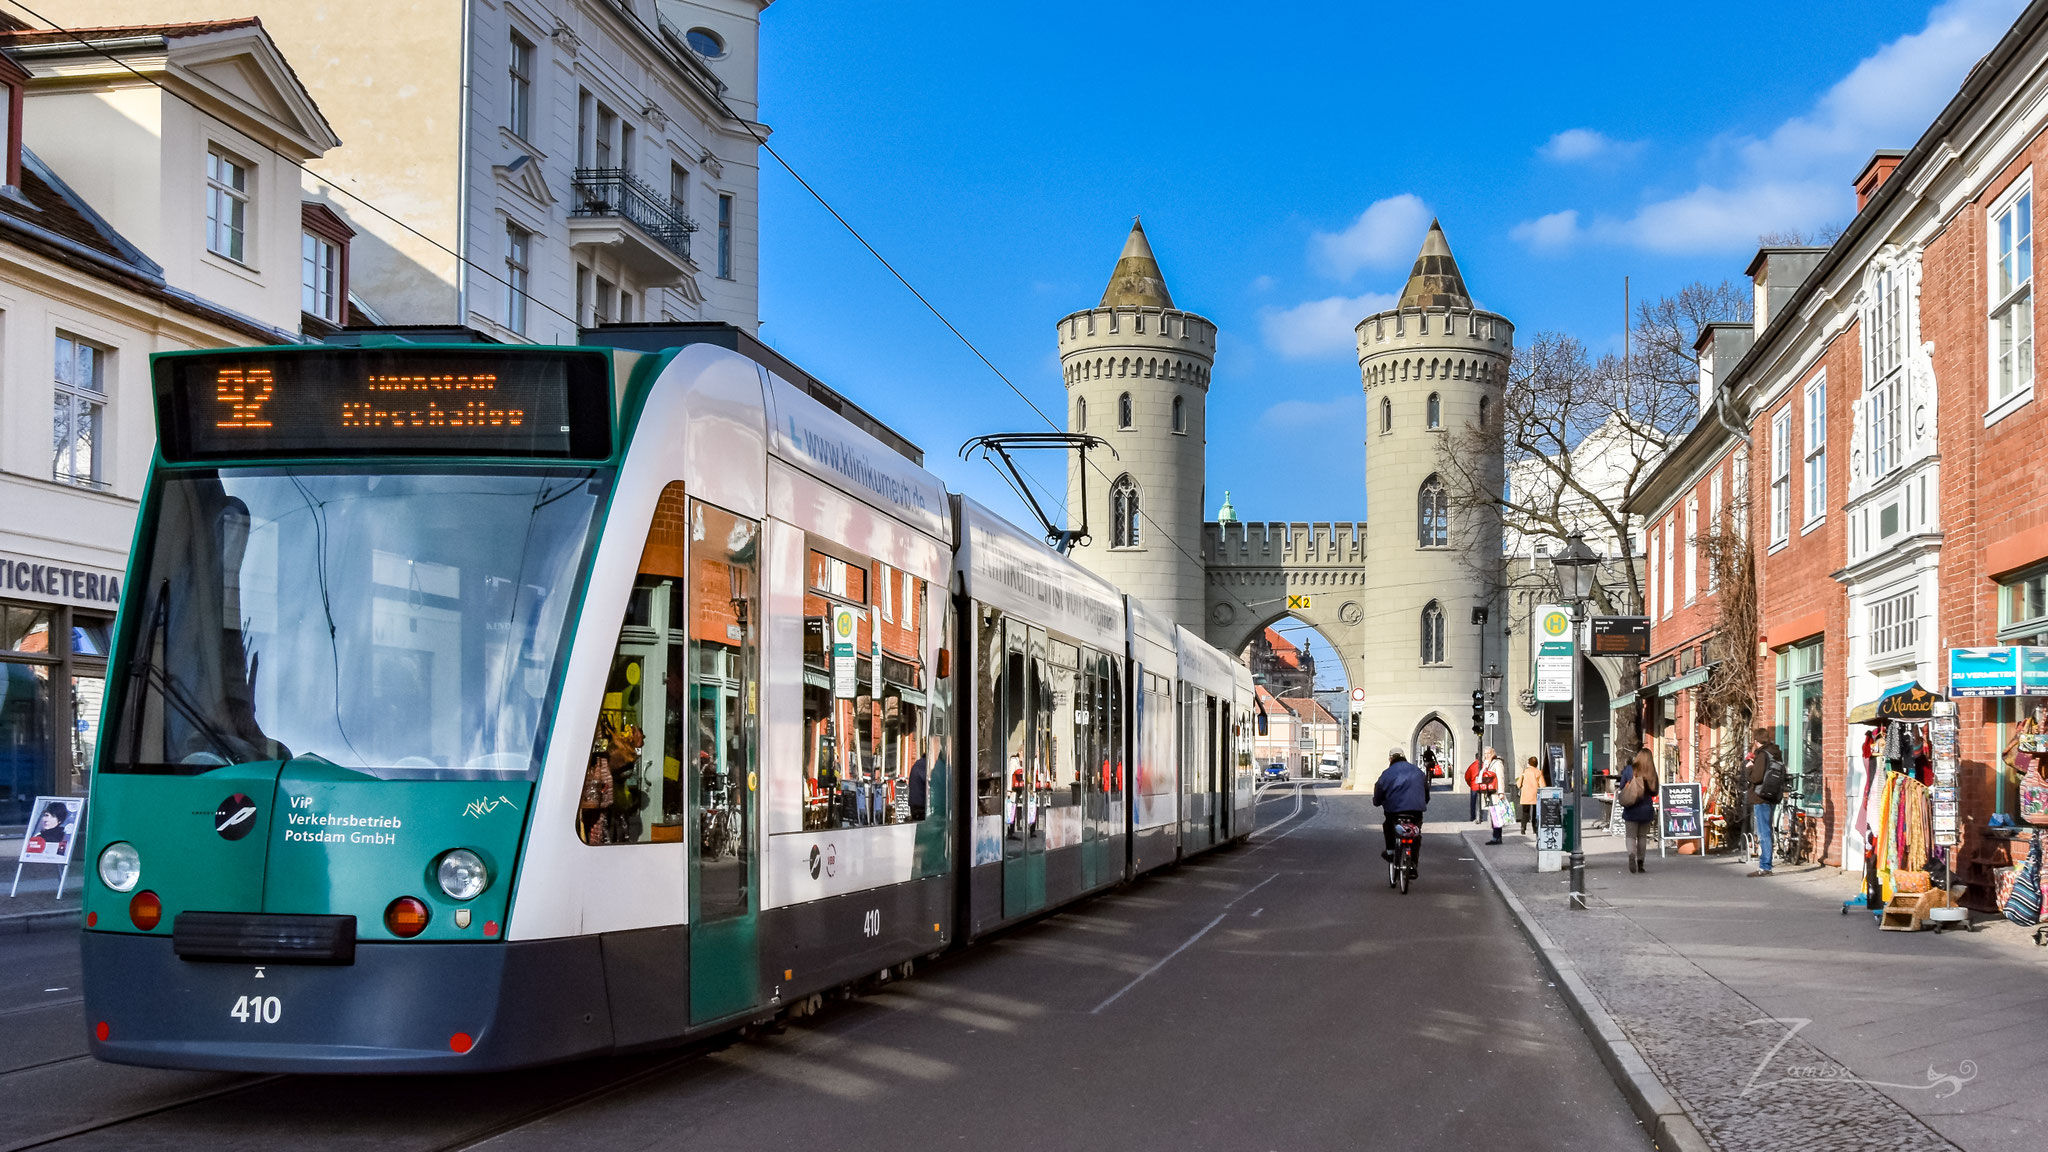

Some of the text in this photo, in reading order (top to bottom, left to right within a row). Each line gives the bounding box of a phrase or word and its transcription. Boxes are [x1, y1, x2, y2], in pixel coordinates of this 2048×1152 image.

[217, 370, 272, 427] 92
[1952, 672, 1965, 680] ZU
[290, 796, 313, 809] ViP
[288, 813, 402, 829] Verkehrsbetrieb
[285, 829, 396, 845] Potsdam GmbH
[863, 908, 880, 938] 410
[230, 995, 282, 1024] 410
